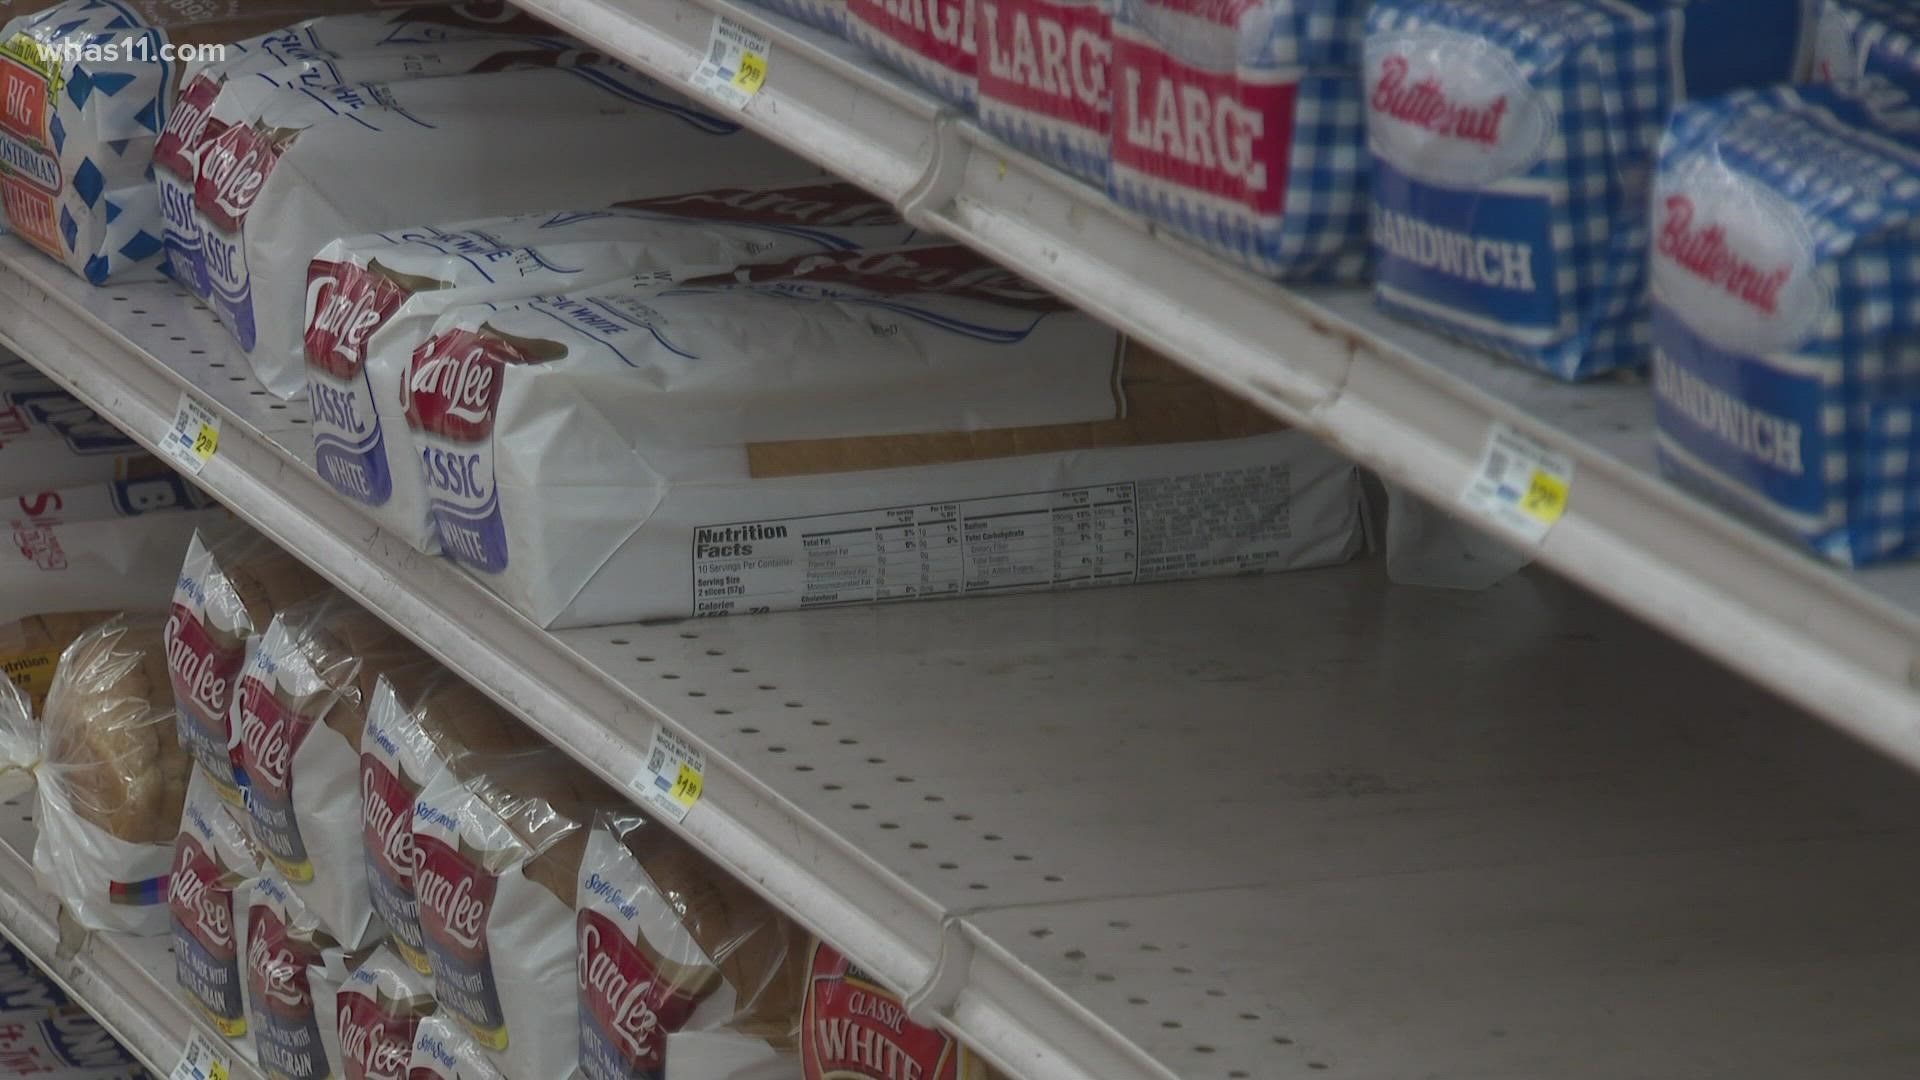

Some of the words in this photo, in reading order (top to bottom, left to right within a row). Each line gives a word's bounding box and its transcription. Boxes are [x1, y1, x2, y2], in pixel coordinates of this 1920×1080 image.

[5, 75, 37, 127] BIG
[446, 347, 494, 424] Lee
[325, 455, 370, 496] WHITE
[698, 525, 788, 544] Nutrition
[802, 539, 819, 548] Total
[820, 537, 832, 547] Fat
[965, 533, 982, 543] Total
[982, 528, 1025, 541] Carbohydrate
[697, 543, 753, 559] Facts
[698, 564, 707, 573] 10
[743, 560, 756, 570] Per
[698, 579, 725, 588] Serving
[726, 576, 740, 585] Size
[698, 601, 735, 611] Calories
[801, 592, 839, 604] Cholesterol
[163, 615, 203, 695] Sara
[190, 652, 227, 720] Lee
[255, 719, 290, 788] Lee
[412, 846, 456, 934] Sara
[444, 877, 484, 950] Lee
[577, 924, 630, 1012] Sara
[612, 979, 658, 1057] Lee
[849, 991, 910, 1035] CLASSIC
